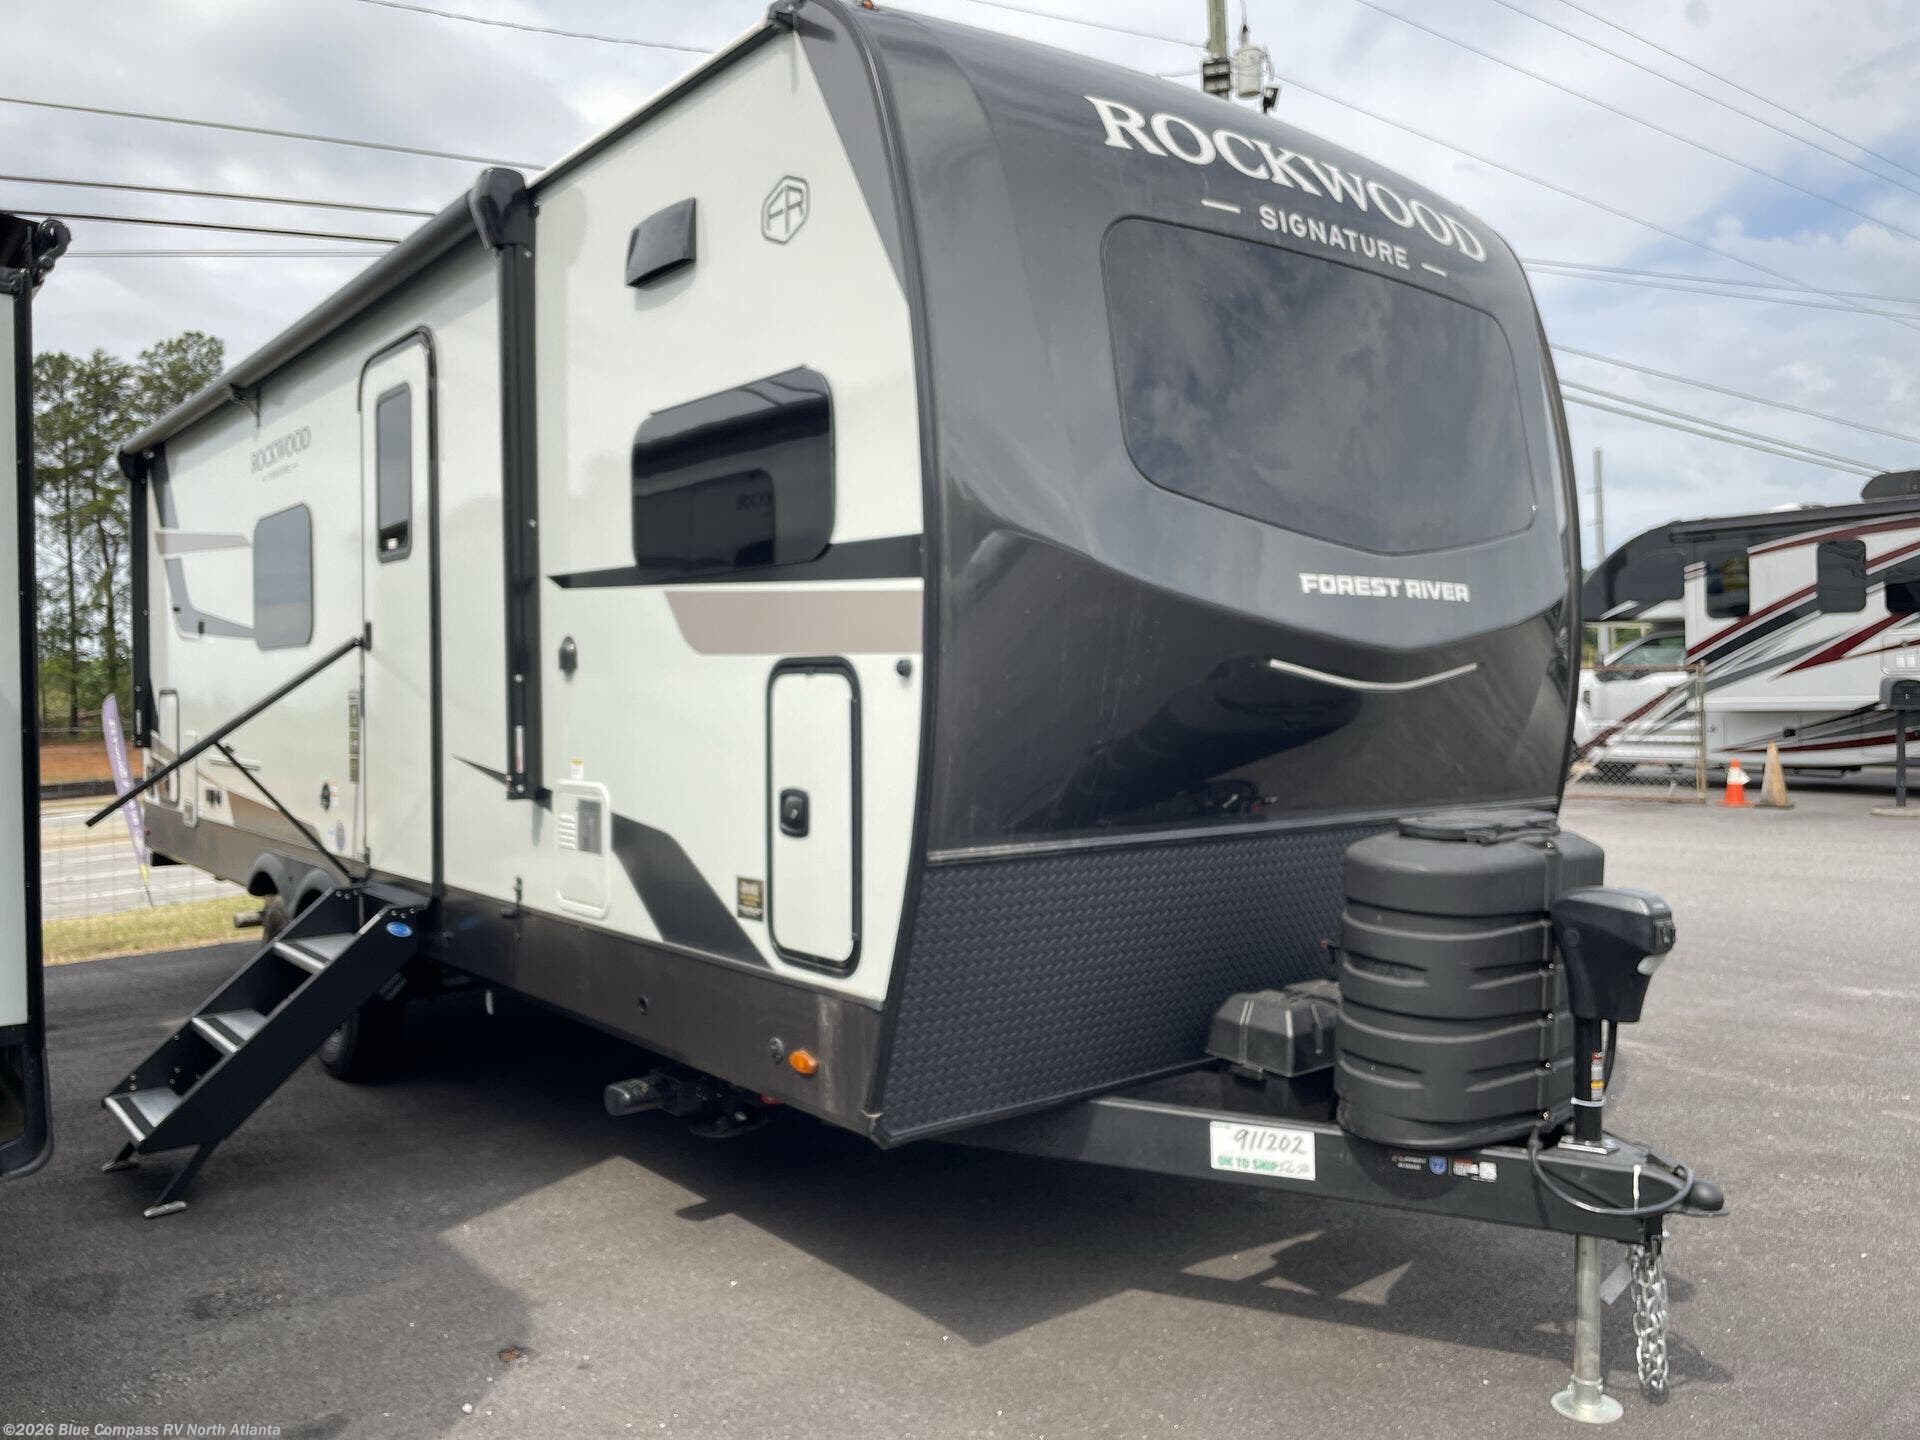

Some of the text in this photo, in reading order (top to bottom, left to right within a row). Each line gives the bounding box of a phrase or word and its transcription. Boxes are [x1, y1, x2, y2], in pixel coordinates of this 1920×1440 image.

[1084, 95, 1487, 263] ROCKWOOD
[1258, 203, 1411, 270] SIGNATURE
[250, 425, 312, 475] ROCKWOOD
[1298, 573, 1471, 603] FOREST RIVER
[1233, 1128, 1307, 1155] 911202
